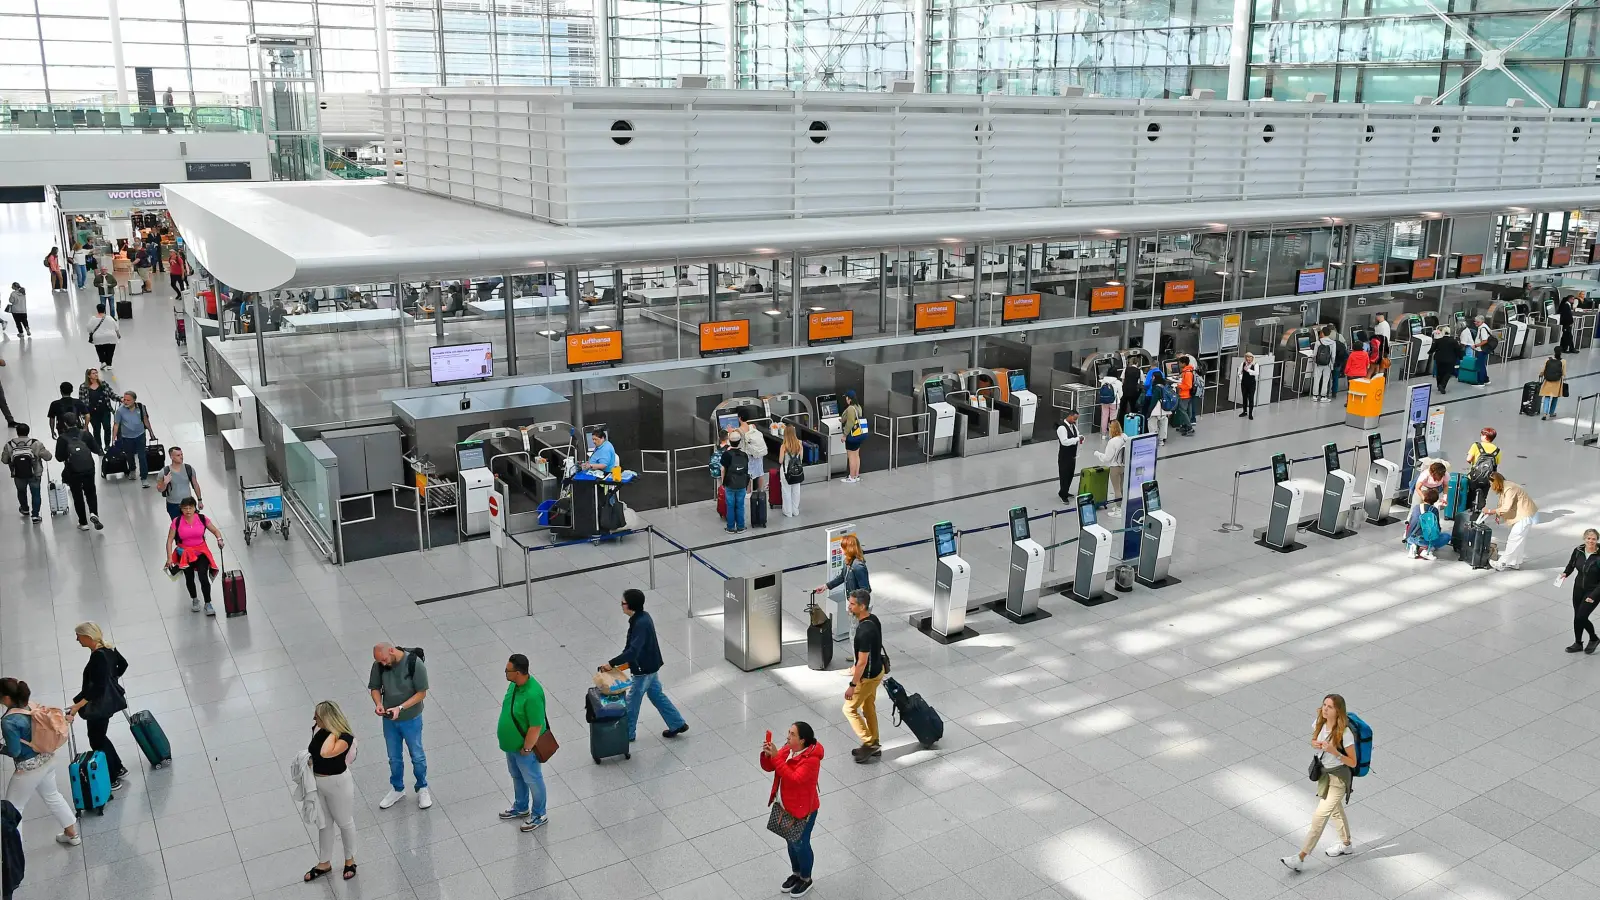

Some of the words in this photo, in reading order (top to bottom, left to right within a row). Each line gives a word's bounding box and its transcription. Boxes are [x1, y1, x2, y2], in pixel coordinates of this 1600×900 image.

[108, 189, 162, 199] worldsho
[820, 315, 845, 323] Lufthansa
[582, 337, 611, 345] Lufthansa
